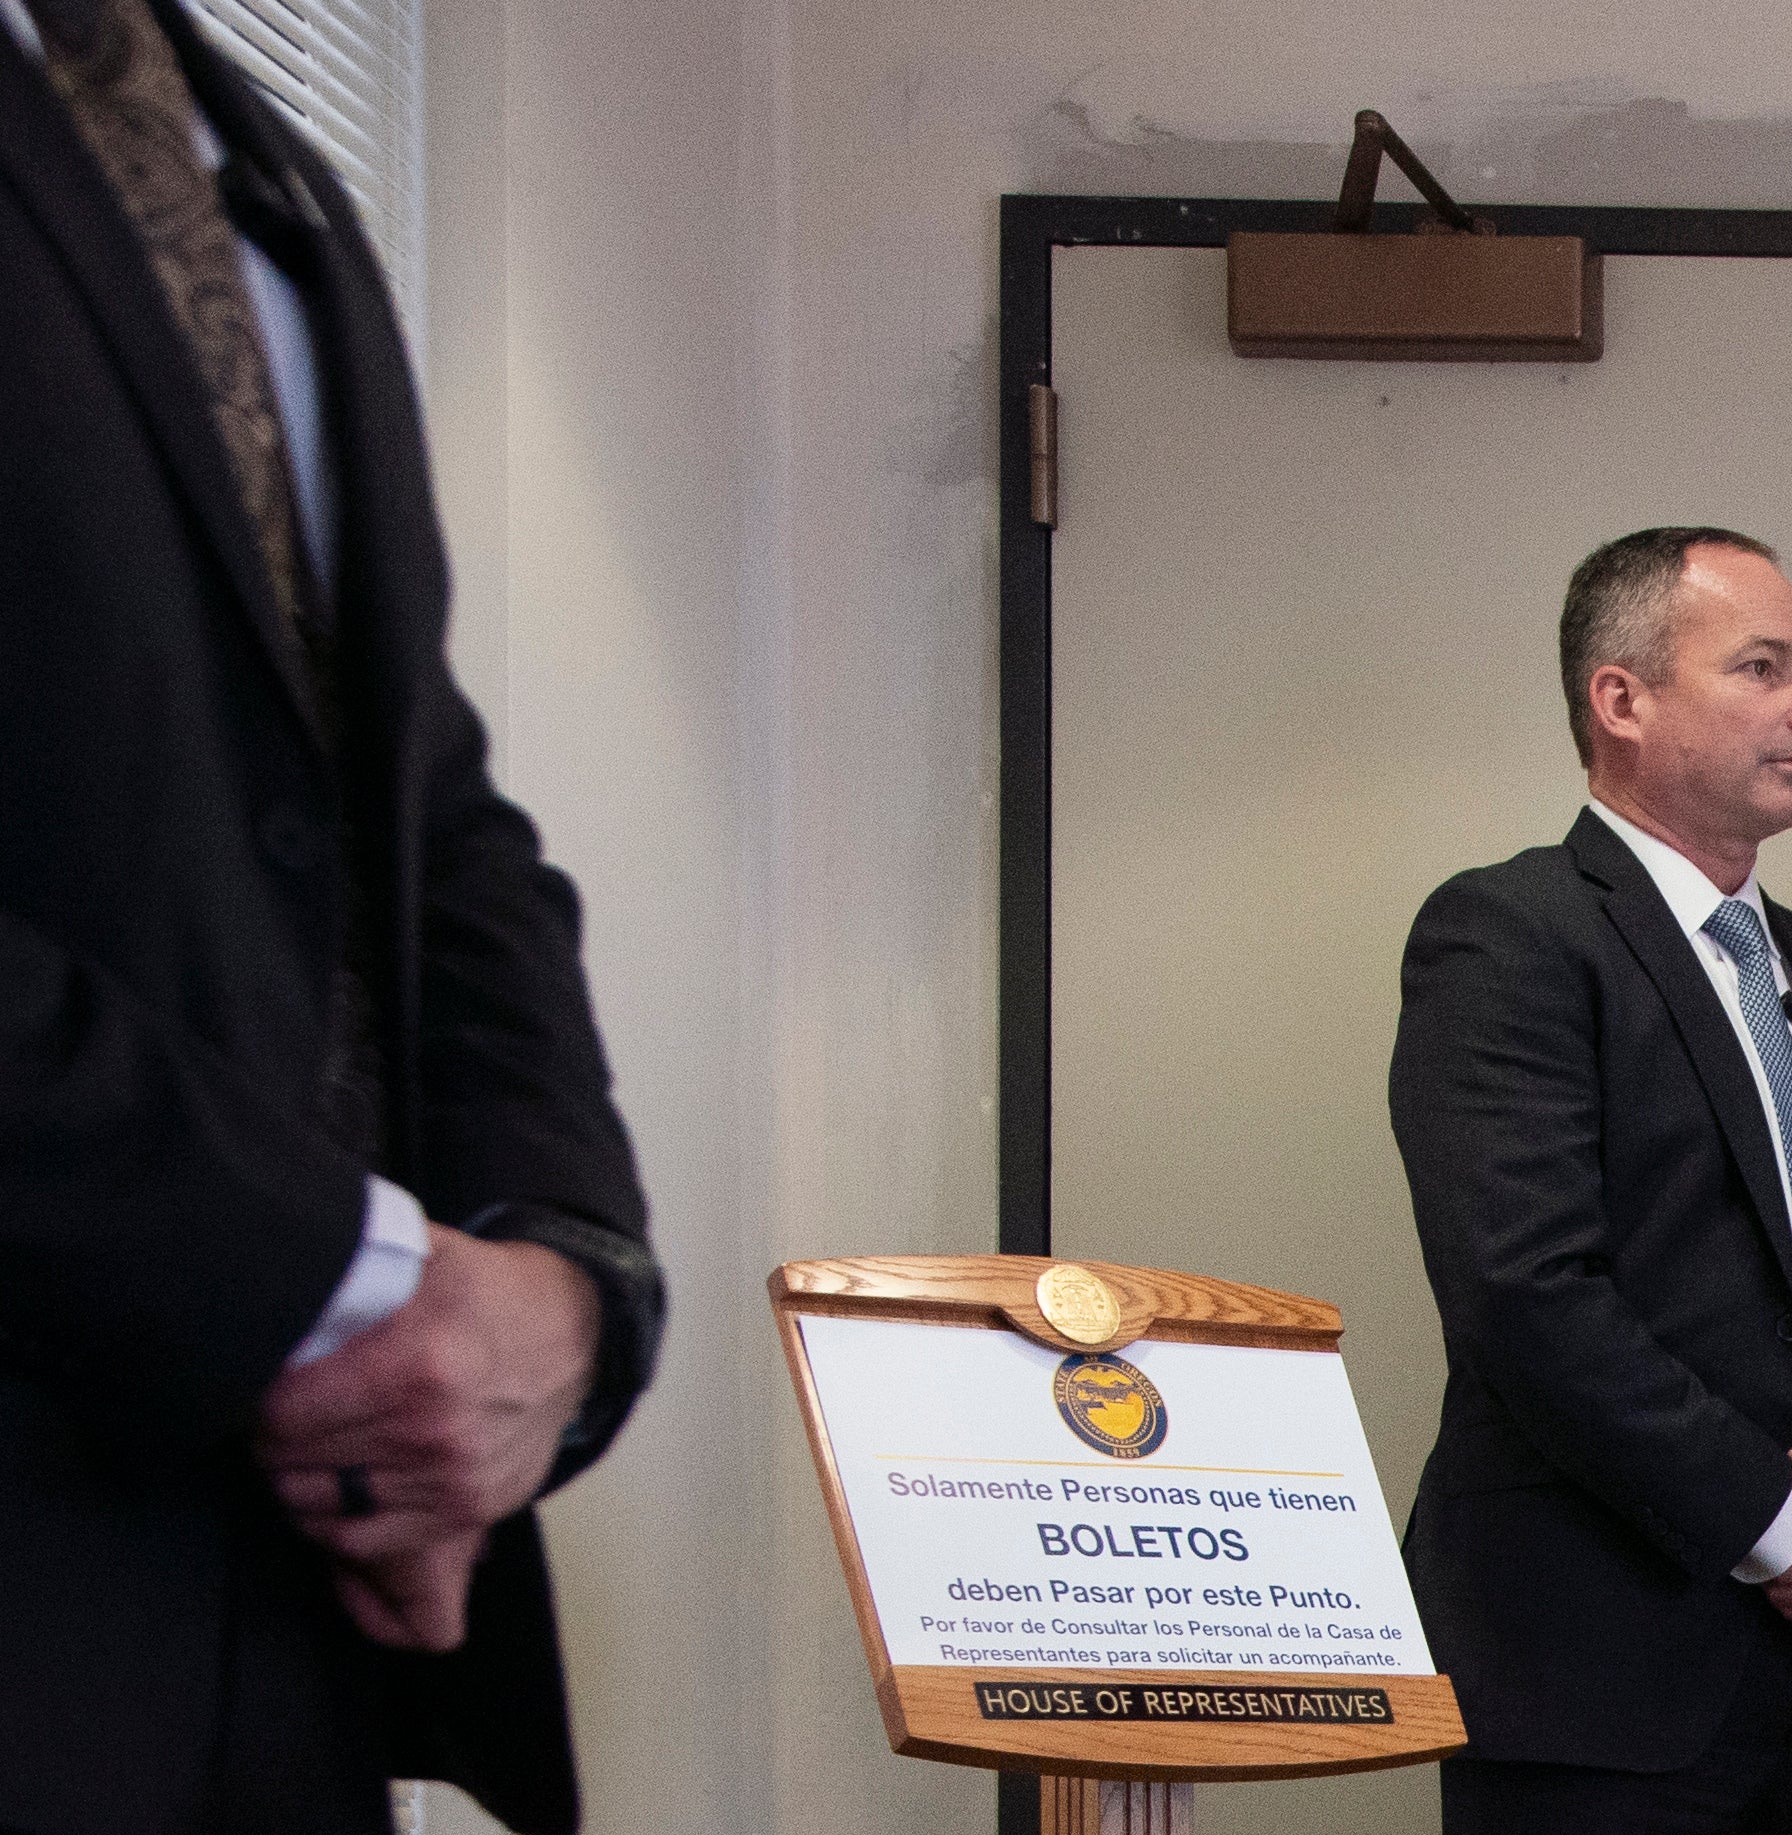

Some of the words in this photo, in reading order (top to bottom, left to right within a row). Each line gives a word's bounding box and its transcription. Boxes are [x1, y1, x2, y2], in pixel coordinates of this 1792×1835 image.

[888, 1471, 1053, 1500] Solamente
[1061, 1479, 1201, 1506] Personas
[1209, 1489, 1262, 1512] que
[1268, 1487, 1357, 1512] tienen
[1037, 1523, 1249, 1561] BOLETOS
[948, 1578, 1042, 1602] deben
[1049, 1579, 1135, 1603] Pasar
[1145, 1587, 1192, 1608] por
[1202, 1585, 1262, 1607] este
[1269, 1585, 1361, 1609] Punto.
[920, 1616, 956, 1632] Por
[963, 1616, 1014, 1634] favor
[1021, 1619, 1046, 1634] de
[1051, 1618, 1148, 1635] Consultar
[1154, 1620, 1184, 1636] los
[1188, 1621, 1272, 1638] Personal
[1278, 1623, 1300, 1638] de
[1305, 1624, 1322, 1638] la
[1327, 1624, 1375, 1640] Casa
[1379, 1625, 1402, 1640] de
[940, 1644, 1101, 1664] Representantes
[1107, 1652, 1151, 1666] para
[1157, 1648, 1233, 1664] solicitar
[1239, 1652, 1263, 1664] un
[1269, 1651, 1401, 1669] acompañante.
[983, 1689, 1088, 1714] HOUSE
[1096, 1690, 1133, 1714] OF
[1143, 1691, 1386, 1718] REPRESENTATIVES
